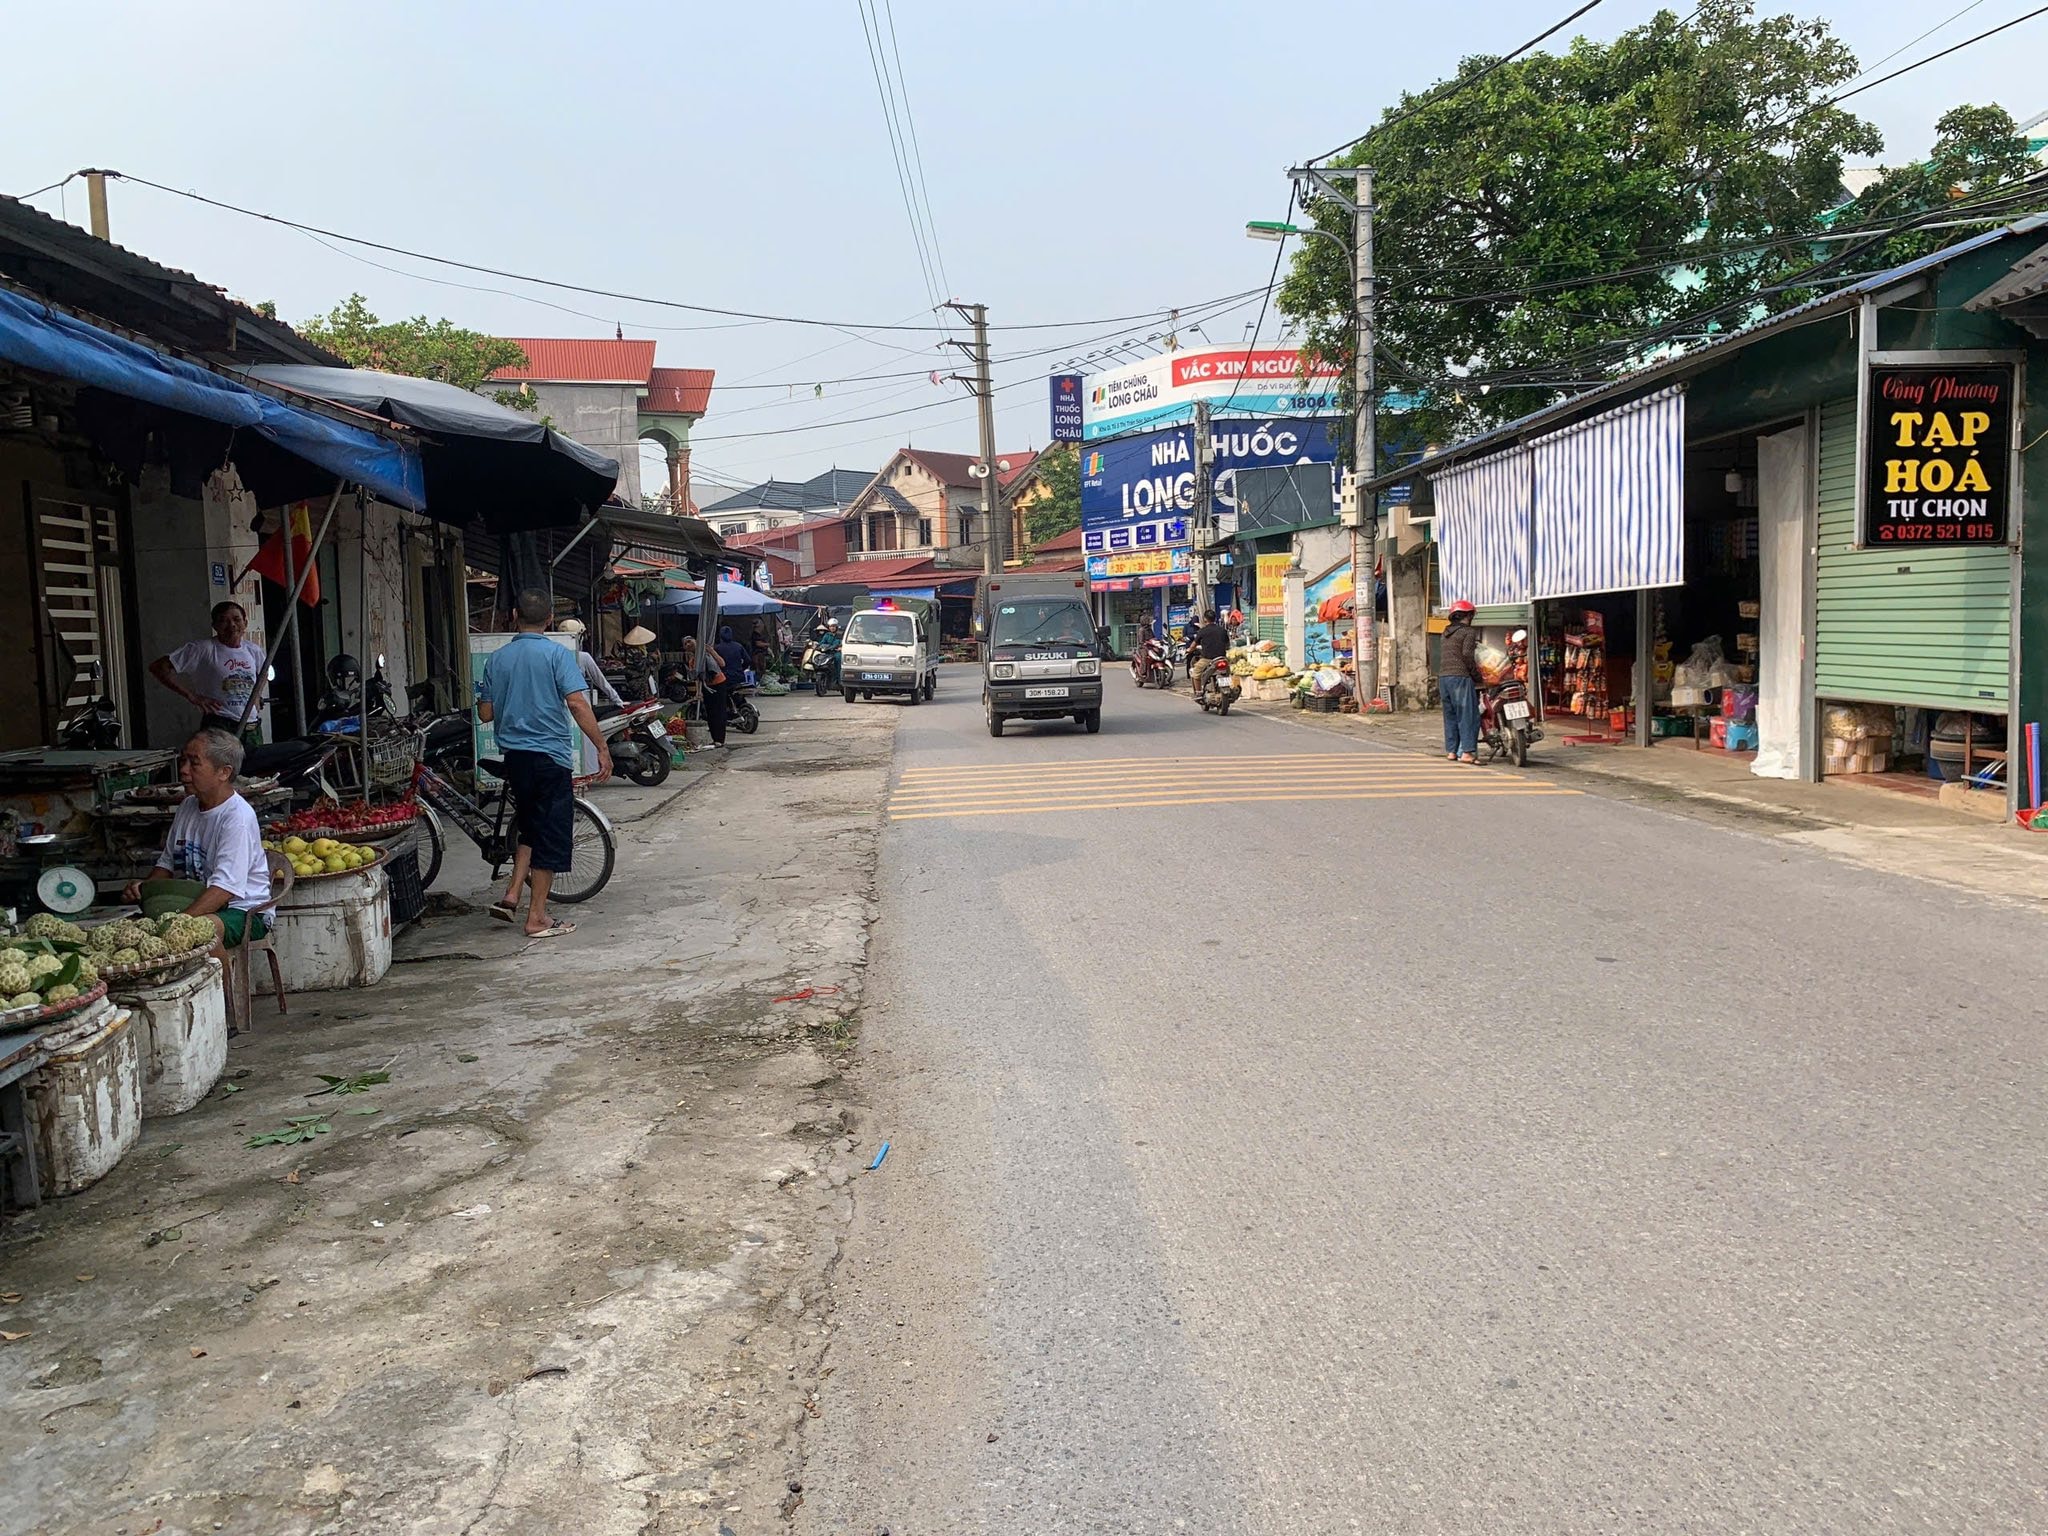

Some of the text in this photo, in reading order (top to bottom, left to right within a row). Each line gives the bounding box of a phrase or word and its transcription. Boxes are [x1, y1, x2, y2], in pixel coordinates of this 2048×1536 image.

[1180, 360, 1211, 380] VẮC
[1215, 361, 1247, 376] XIN
[1060, 394, 1075, 402] NHÀ
[1109, 385, 1158, 409] LONG CHÂU
[1291, 396, 1327, 409] 1800
[1055, 404, 1080, 413] THUỐC
[1055, 415, 1081, 424] LONG
[1055, 427, 1082, 437] CHÂU
[1211, 421, 1297, 457] HUỐC
[1890, 411, 1990, 453] TẠP
[1152, 433, 1190, 466] NHÀ
[1884, 450, 1992, 493] HOÁ
[1122, 472, 1195, 518] LONG
[1887, 498, 1987, 521] TỰ CHỌN
[1897, 524, 1993, 539] 0372 521 915
[1025, 652, 1068, 661] SUZUKI
